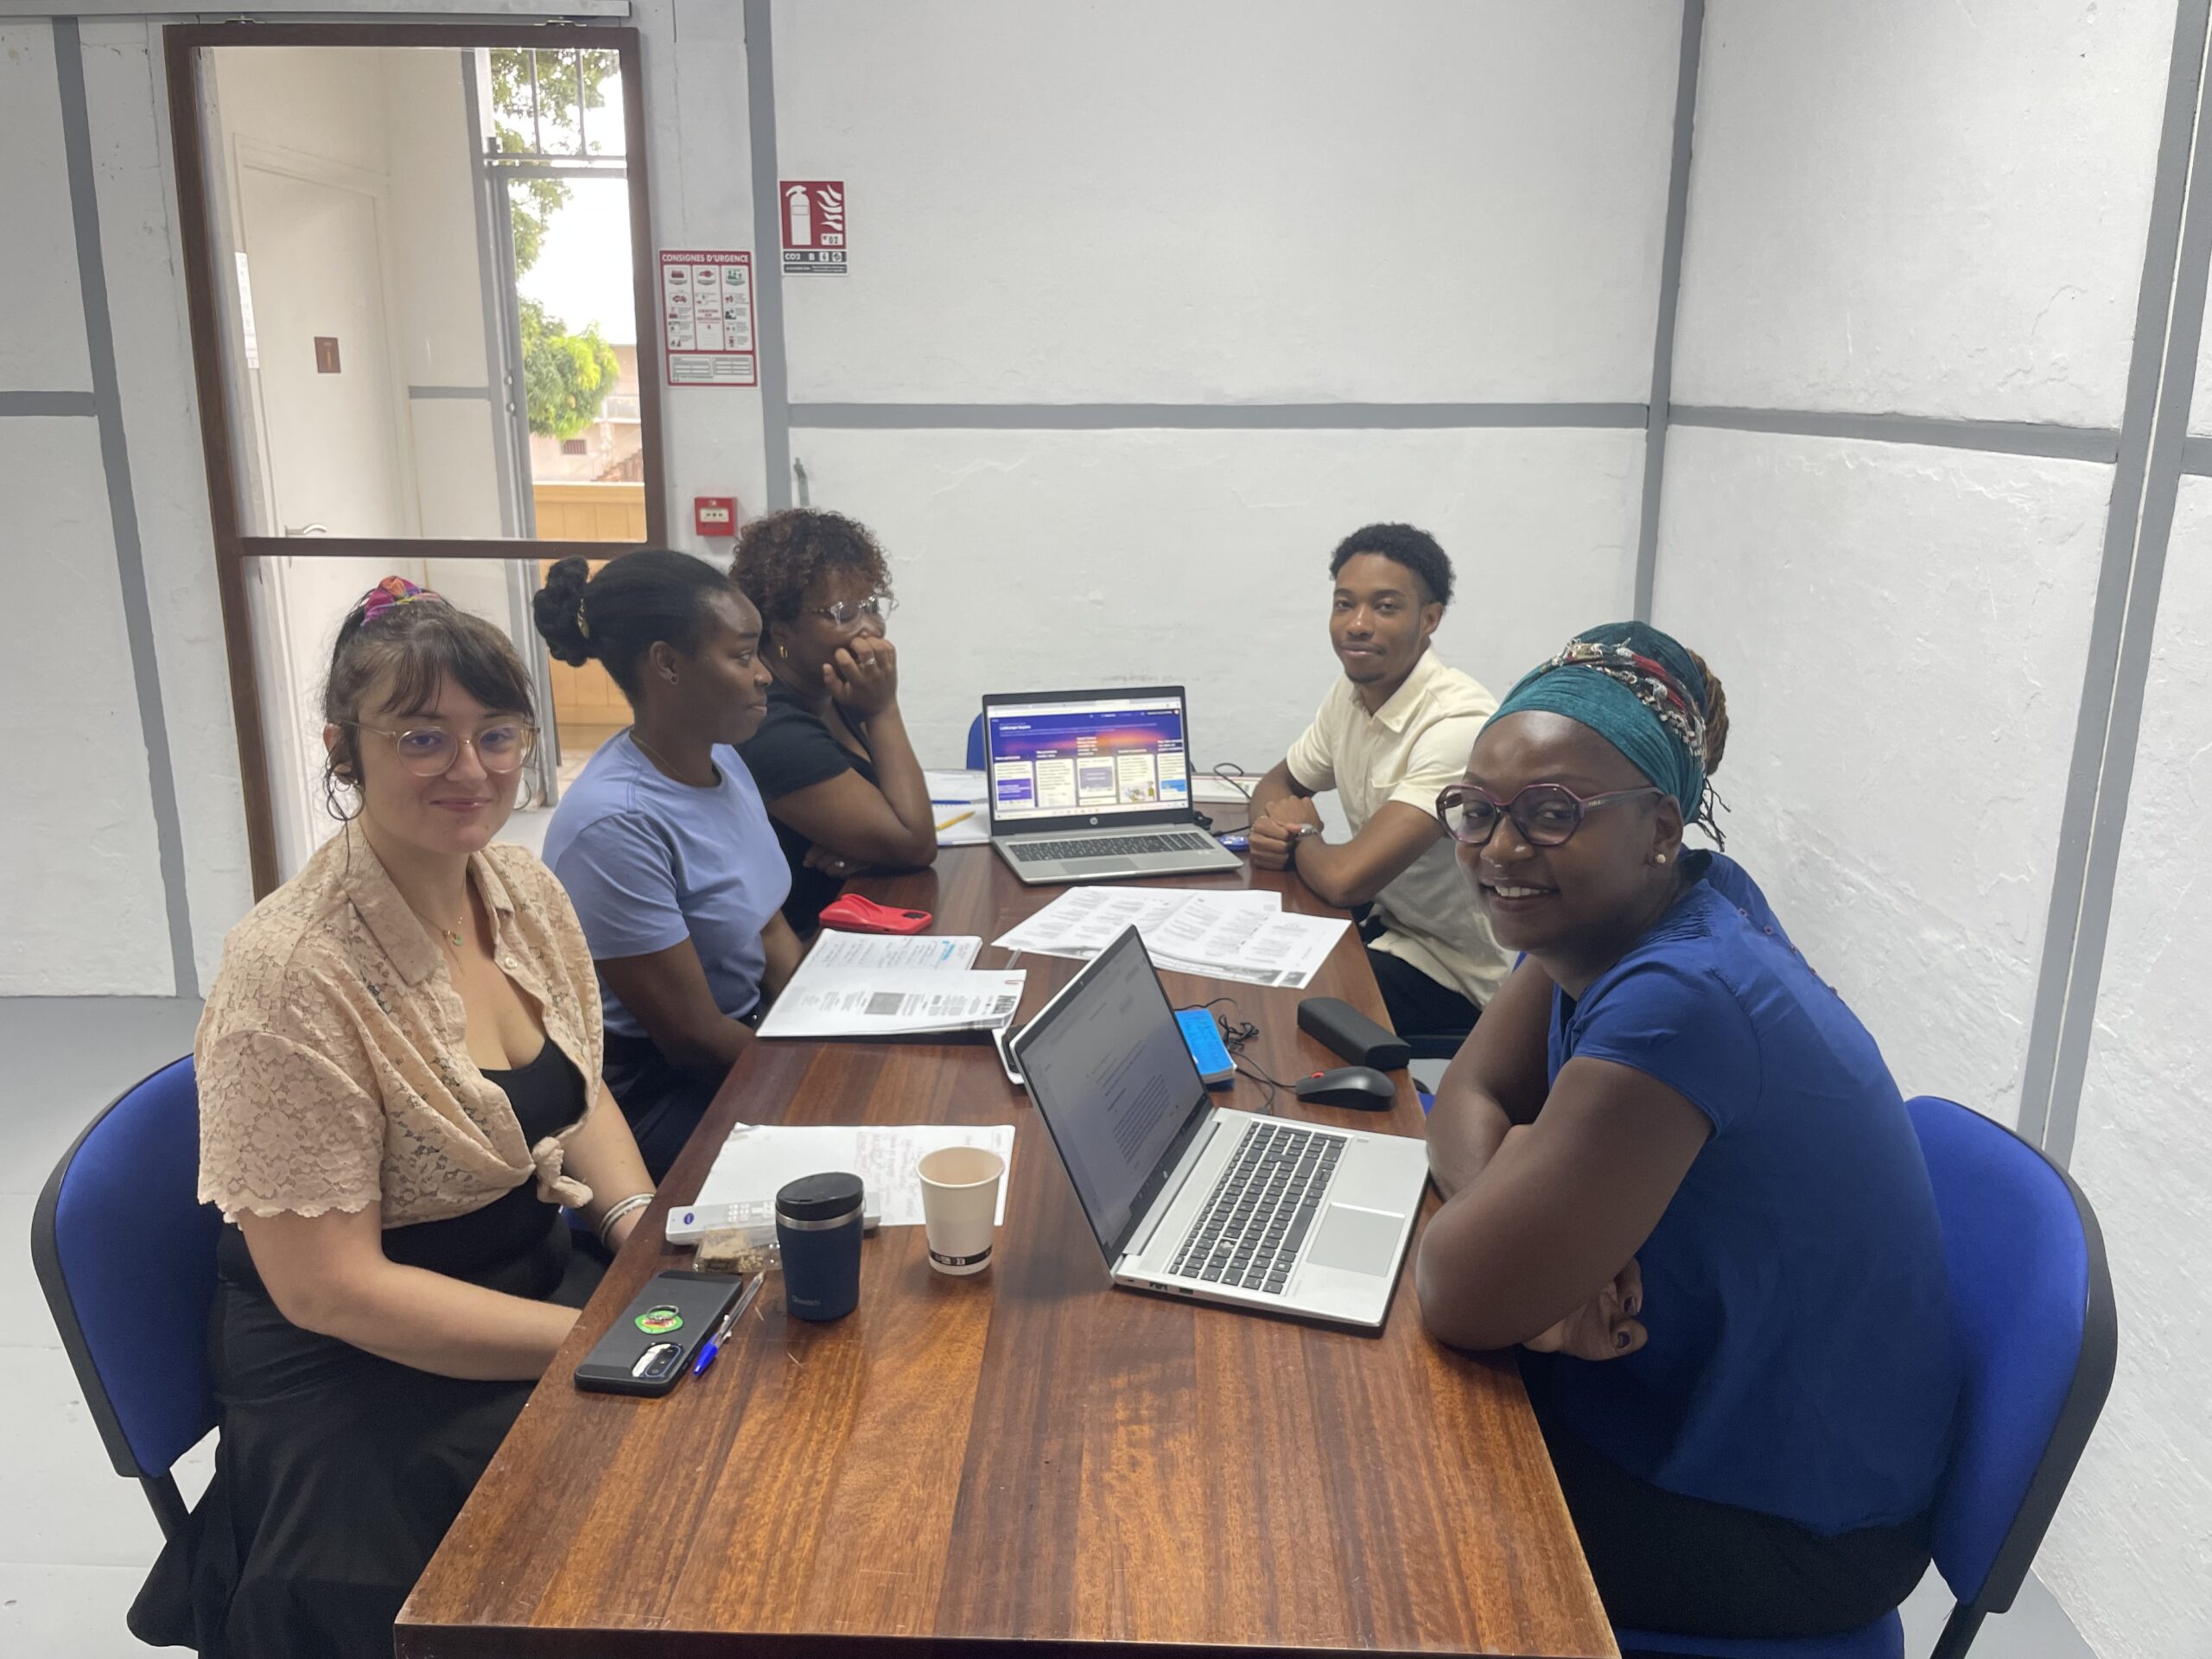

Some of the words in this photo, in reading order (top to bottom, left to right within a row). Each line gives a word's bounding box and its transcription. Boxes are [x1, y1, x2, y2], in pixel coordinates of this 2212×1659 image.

[706, 254, 749, 263] D'URGENCE
[785, 252, 802, 261] CO2
[808, 252, 816, 261] B
